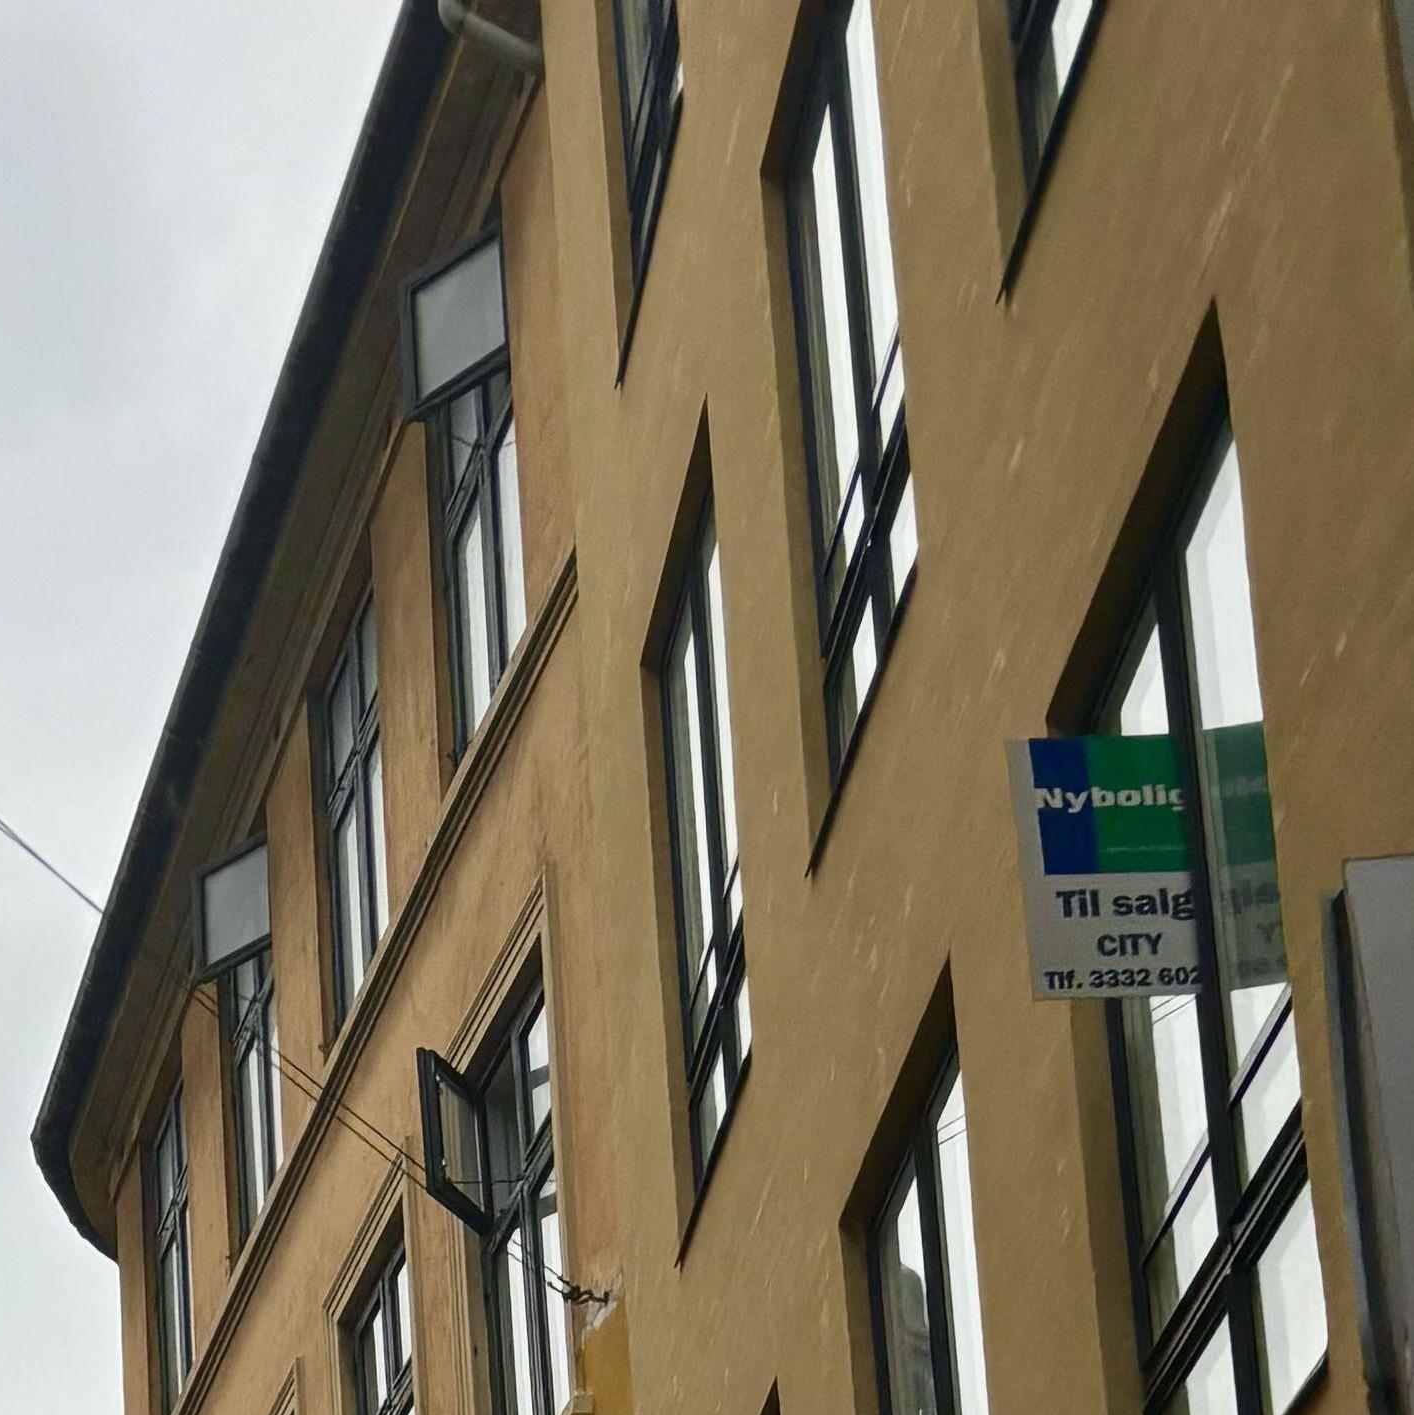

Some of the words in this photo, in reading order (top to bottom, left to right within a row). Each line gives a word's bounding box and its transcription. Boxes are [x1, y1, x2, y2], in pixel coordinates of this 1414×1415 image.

[1056, 888, 1101, 918] Til
[1112, 888, 1196, 921] salg
[1097, 933, 1162, 957] CITY
[1044, 969, 1083, 990] Tlf.
[1089, 968, 1151, 989] 3332
